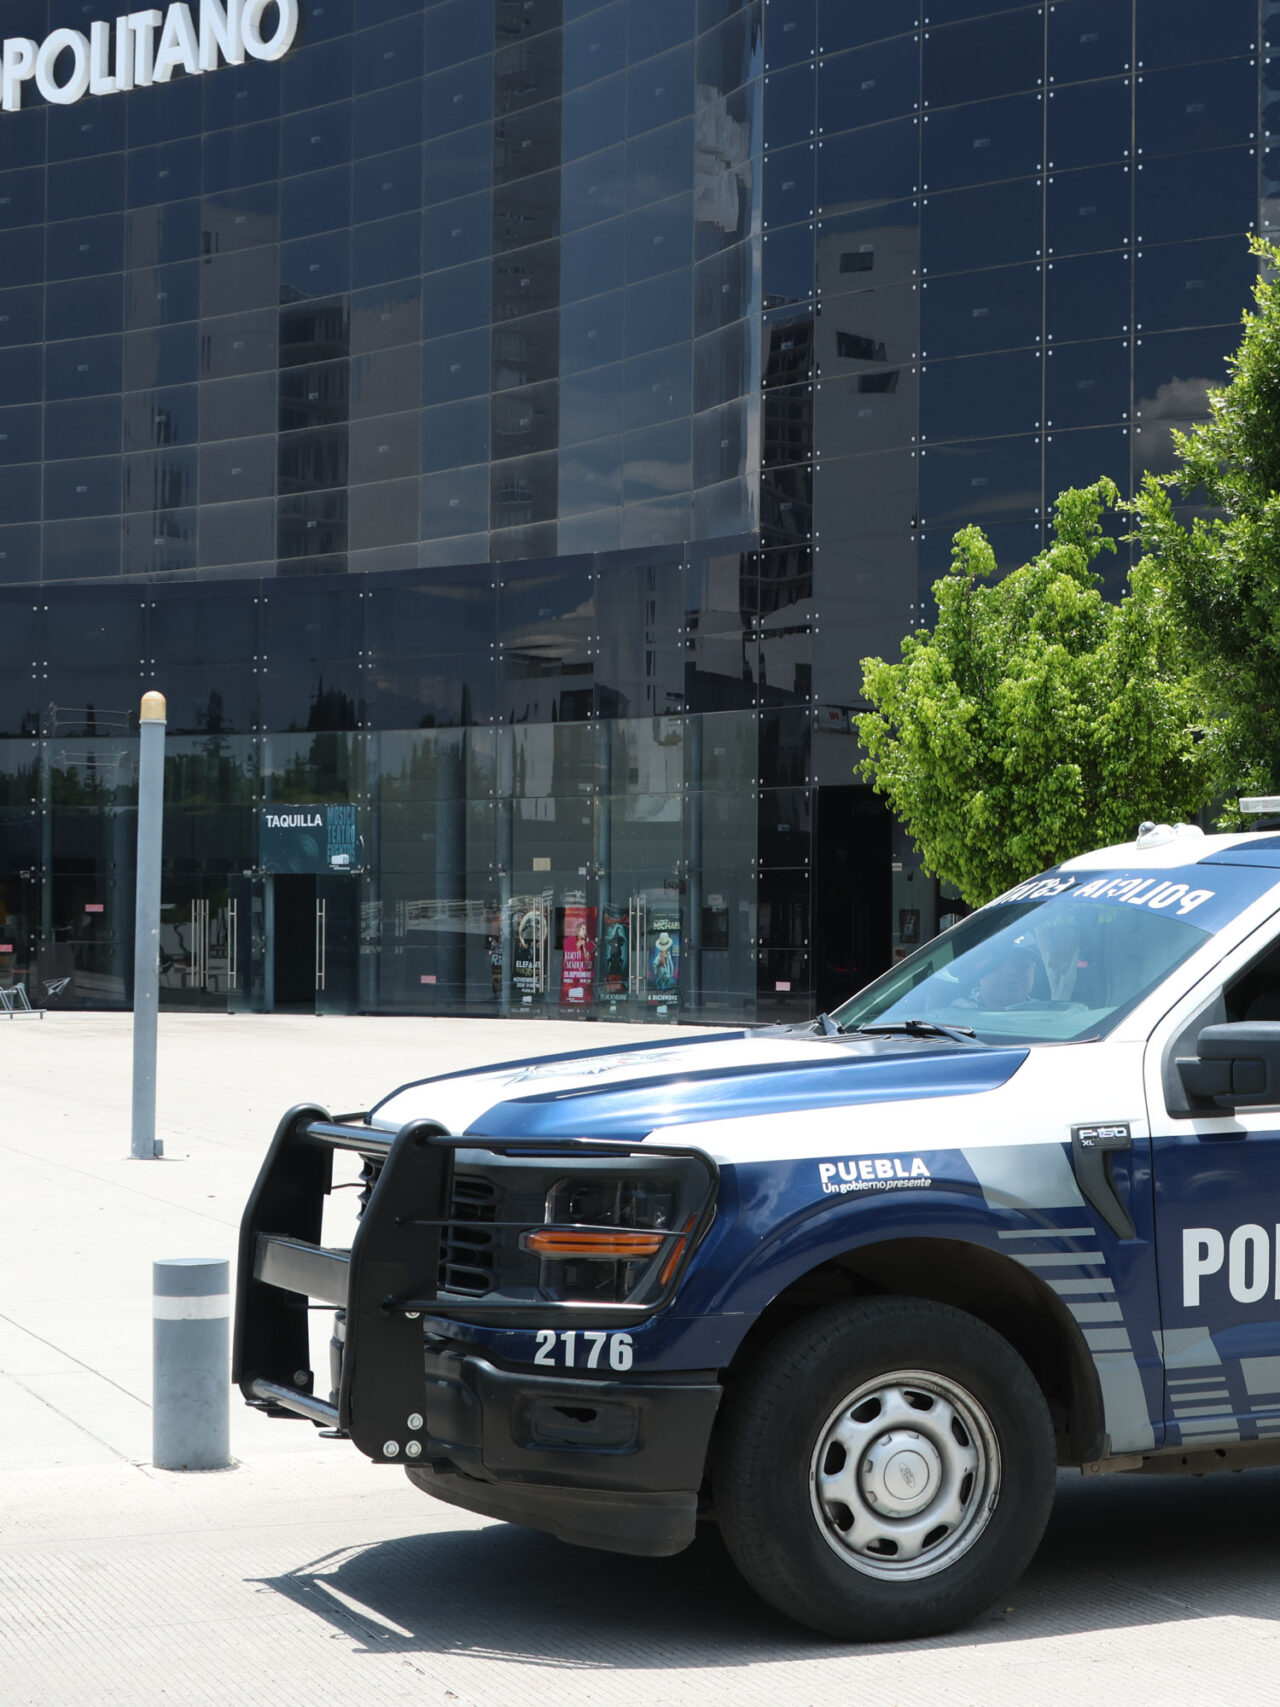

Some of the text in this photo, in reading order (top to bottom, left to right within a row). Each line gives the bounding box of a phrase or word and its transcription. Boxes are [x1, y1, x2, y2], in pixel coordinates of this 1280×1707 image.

[0, 0, 299, 111] POLITANO
[266, 814, 322, 828] TAQUILLA
[516, 961, 543, 969] ELEFAT
[1079, 1127, 1128, 1139] F-150
[819, 1157, 931, 1183] PUEBLA
[822, 1178, 931, 1194] Un gobierno presente
[534, 1329, 633, 1371] 2176
